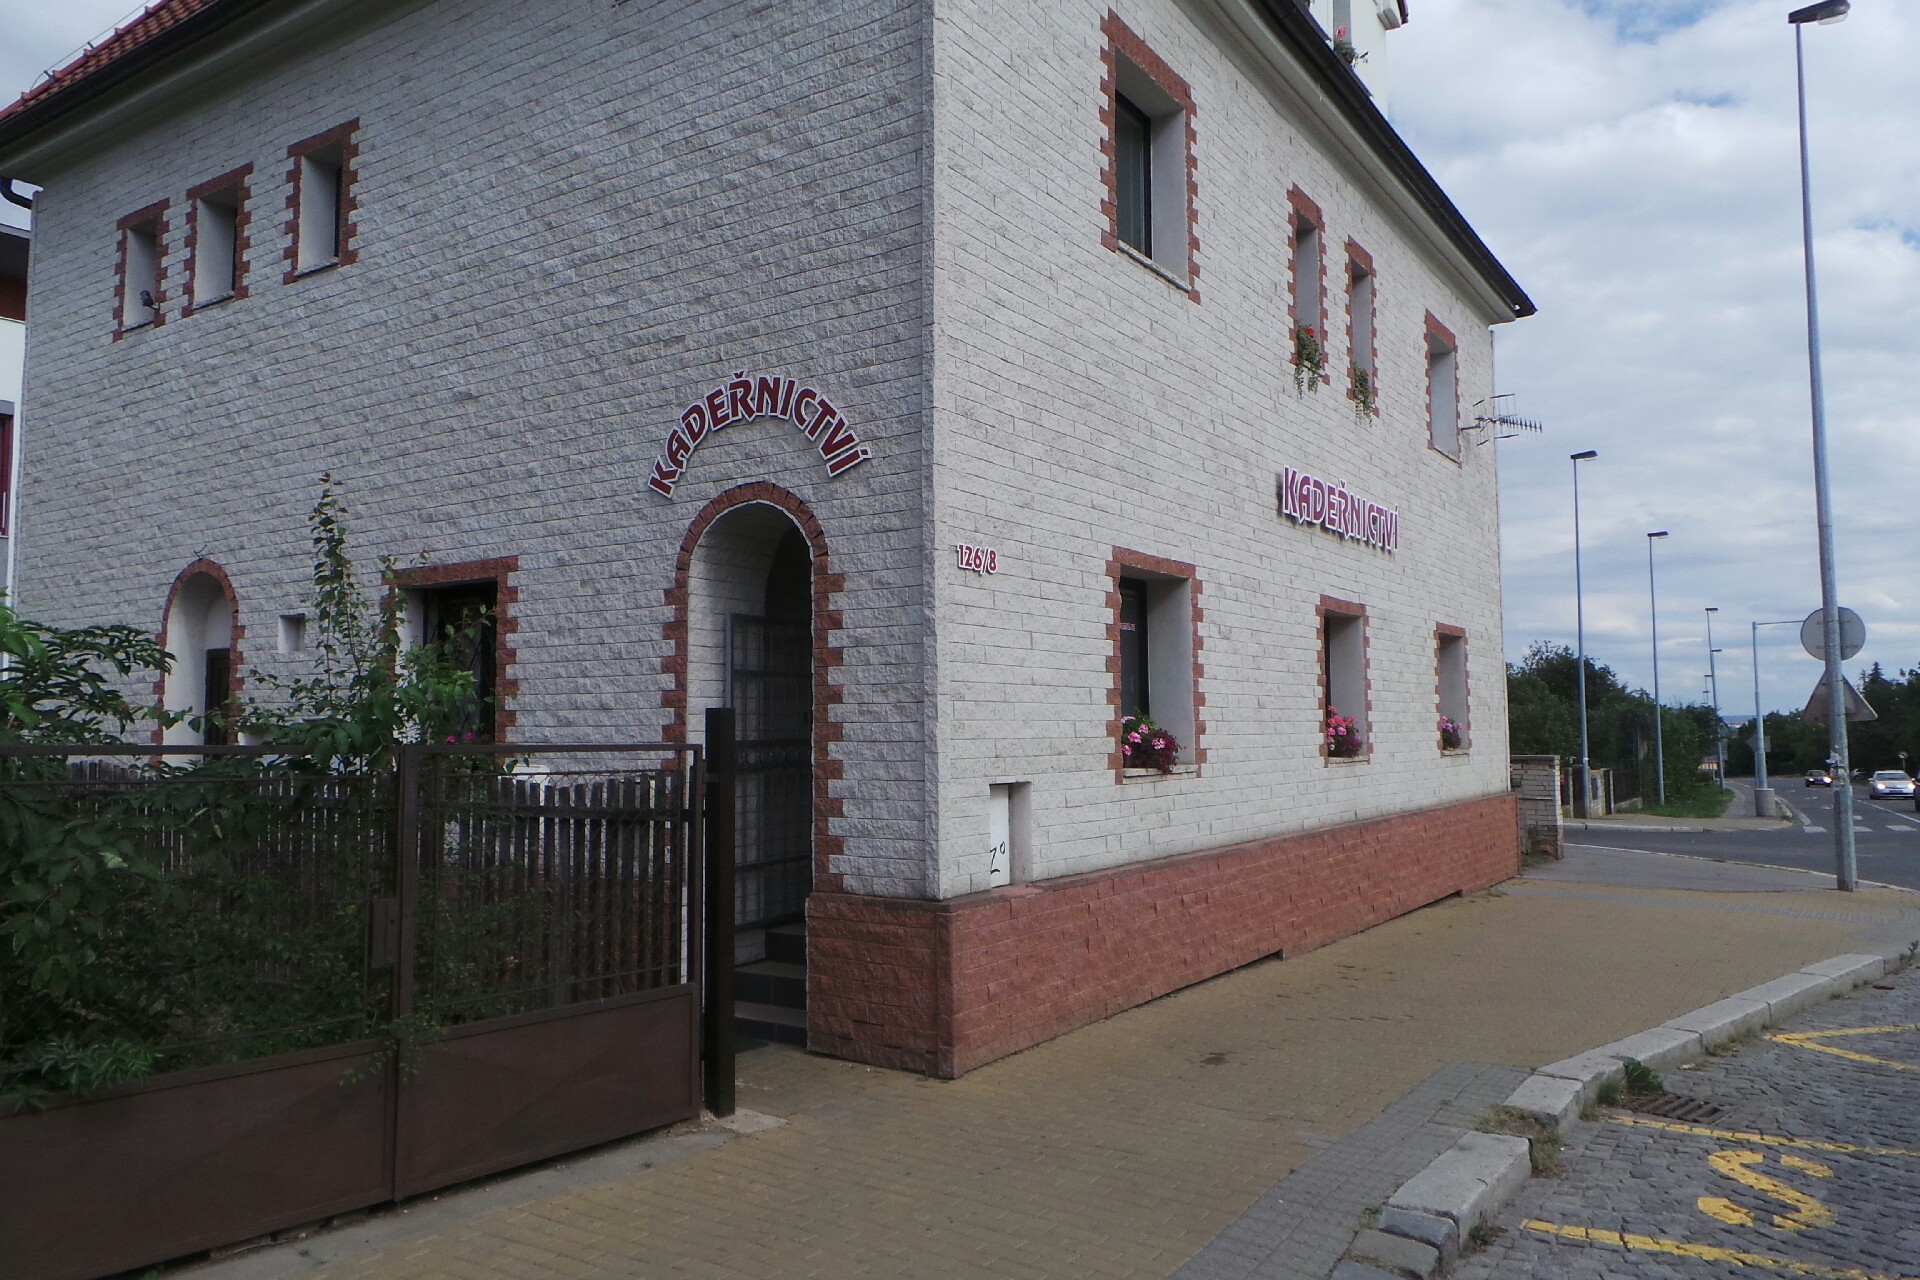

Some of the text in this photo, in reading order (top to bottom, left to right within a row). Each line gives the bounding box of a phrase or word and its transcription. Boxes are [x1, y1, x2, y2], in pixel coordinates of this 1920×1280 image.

[648, 370, 873, 498] KADEŘNICTVÍ
[1282, 464, 1399, 551] KADEŘNICTVÍ
[957, 543, 998, 574] 126/8
